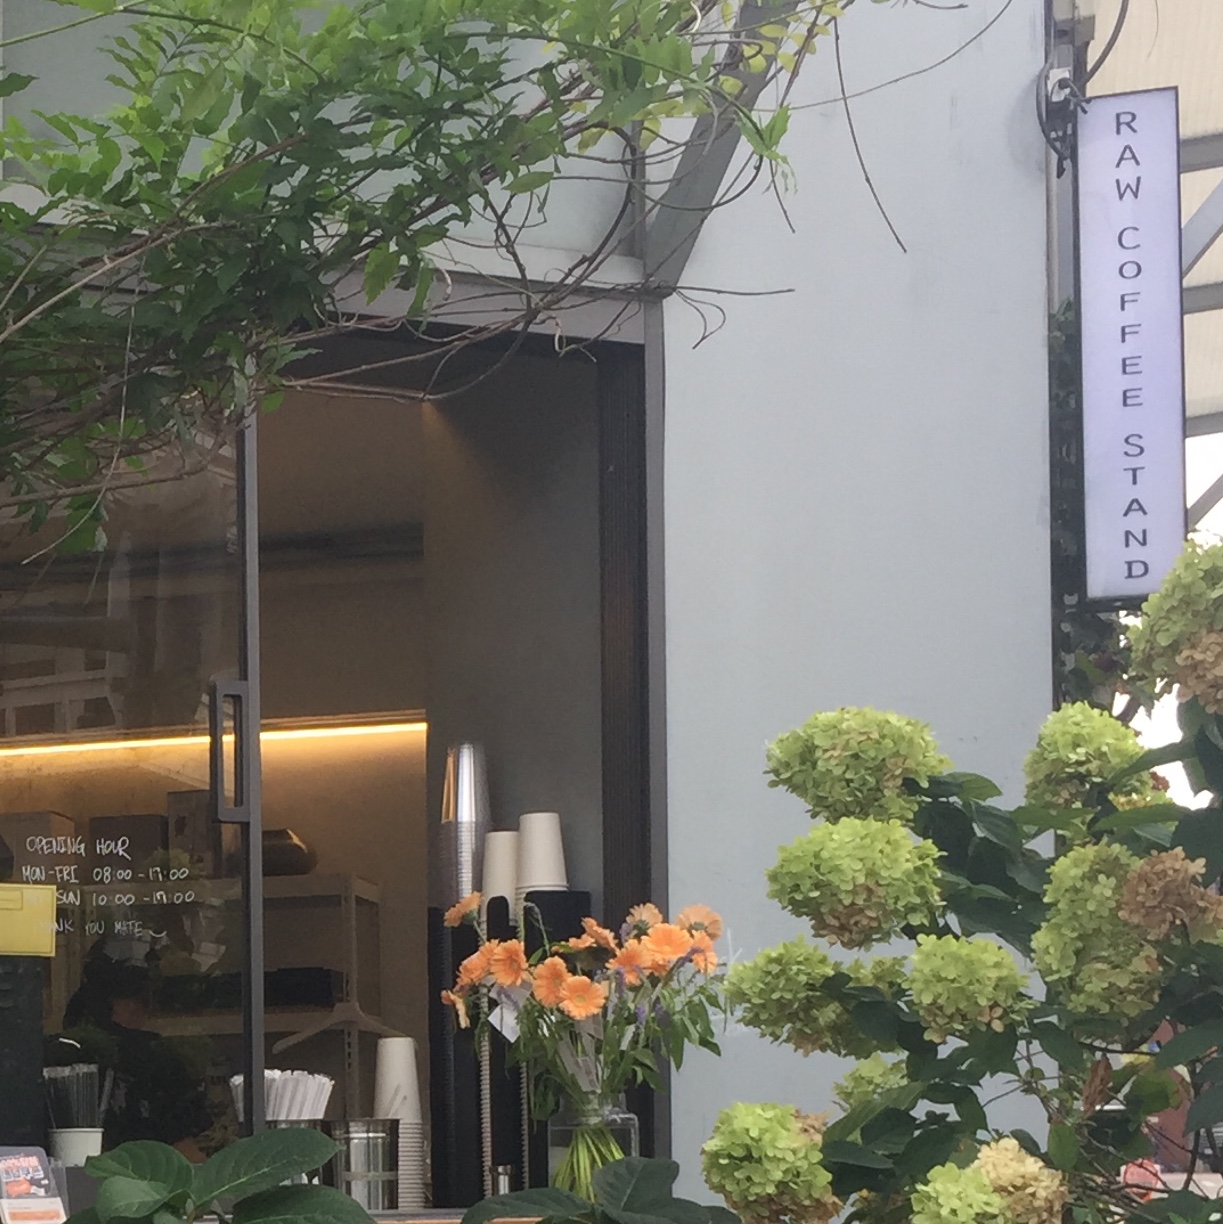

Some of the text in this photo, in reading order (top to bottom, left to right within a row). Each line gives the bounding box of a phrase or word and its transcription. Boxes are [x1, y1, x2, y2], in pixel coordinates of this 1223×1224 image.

[1114, 111, 1150, 580] RAW COFFEE STAND
[25, 835, 132, 861] OPENING HOUR
